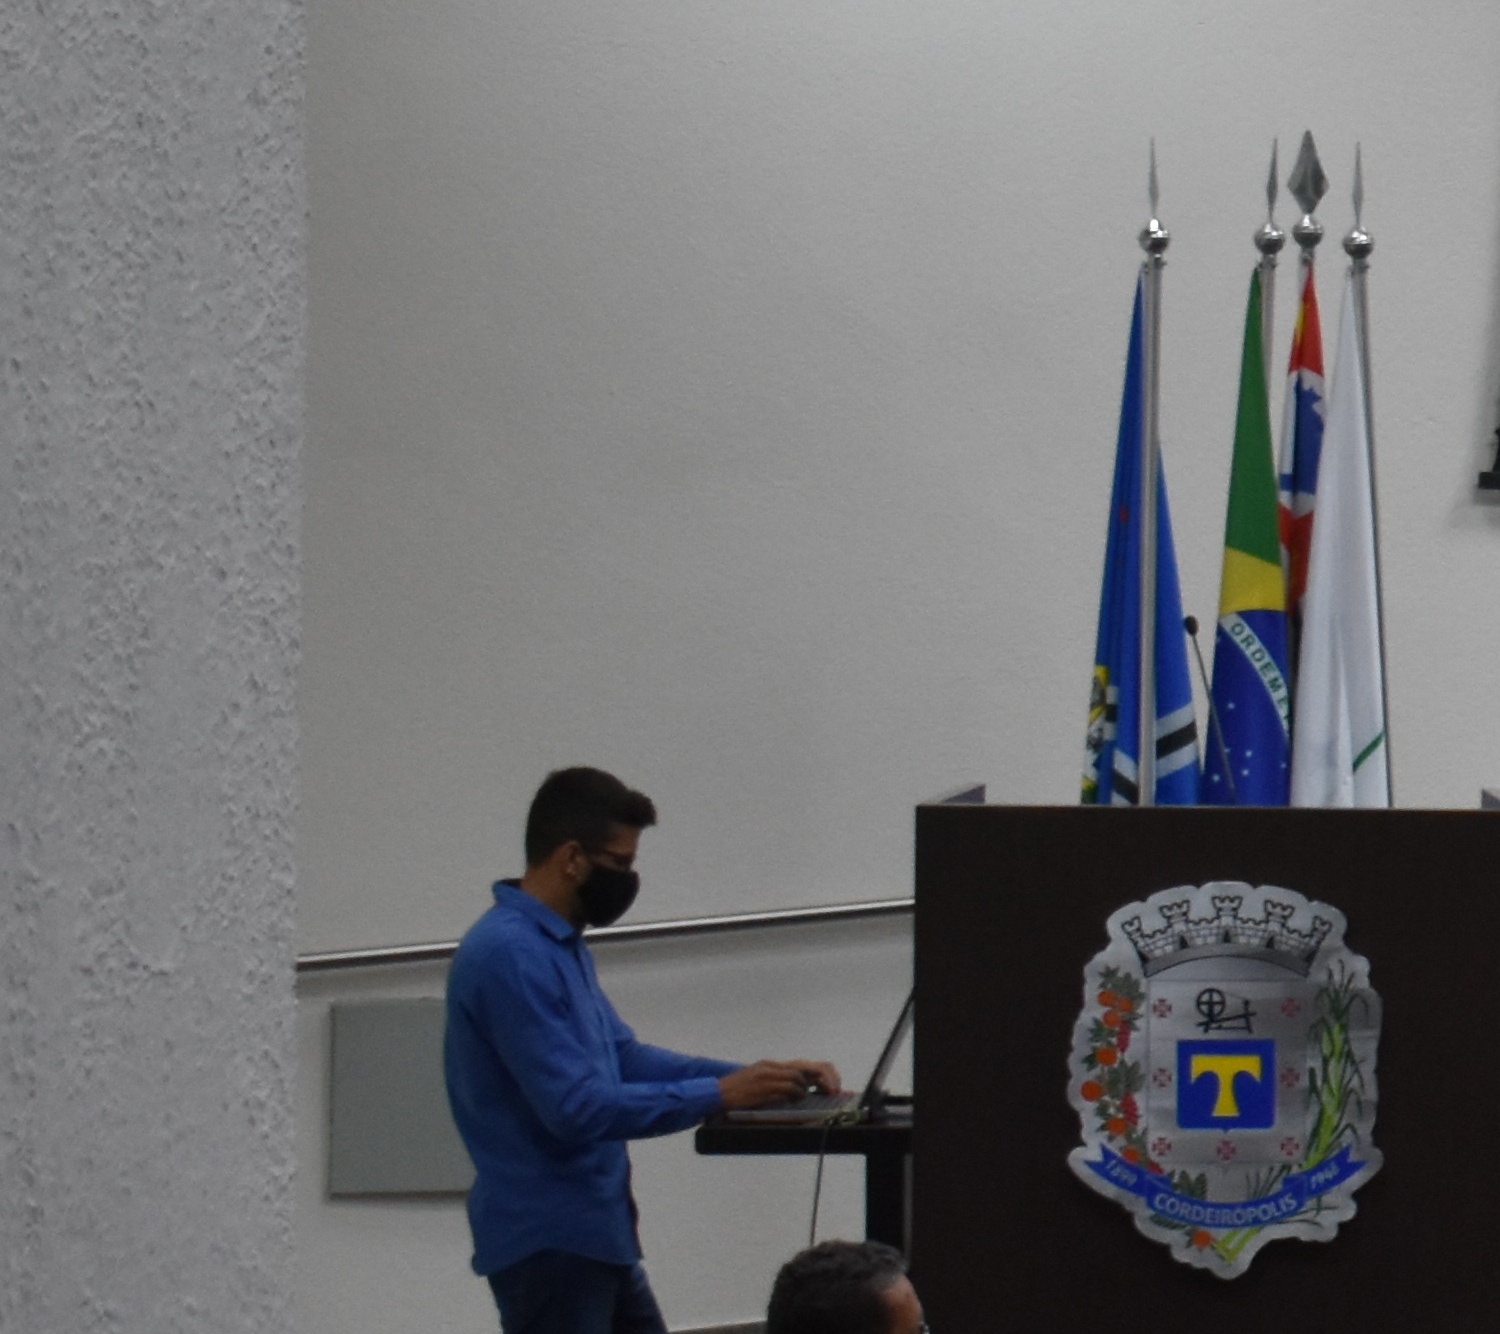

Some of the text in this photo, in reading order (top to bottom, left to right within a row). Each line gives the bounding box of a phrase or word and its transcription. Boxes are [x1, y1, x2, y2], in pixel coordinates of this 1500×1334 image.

[1231, 622, 1284, 692] ORDEM
[1190, 1054, 1262, 1117] T
[1153, 1192, 1297, 1225] CORDEIRÓPOLIS
